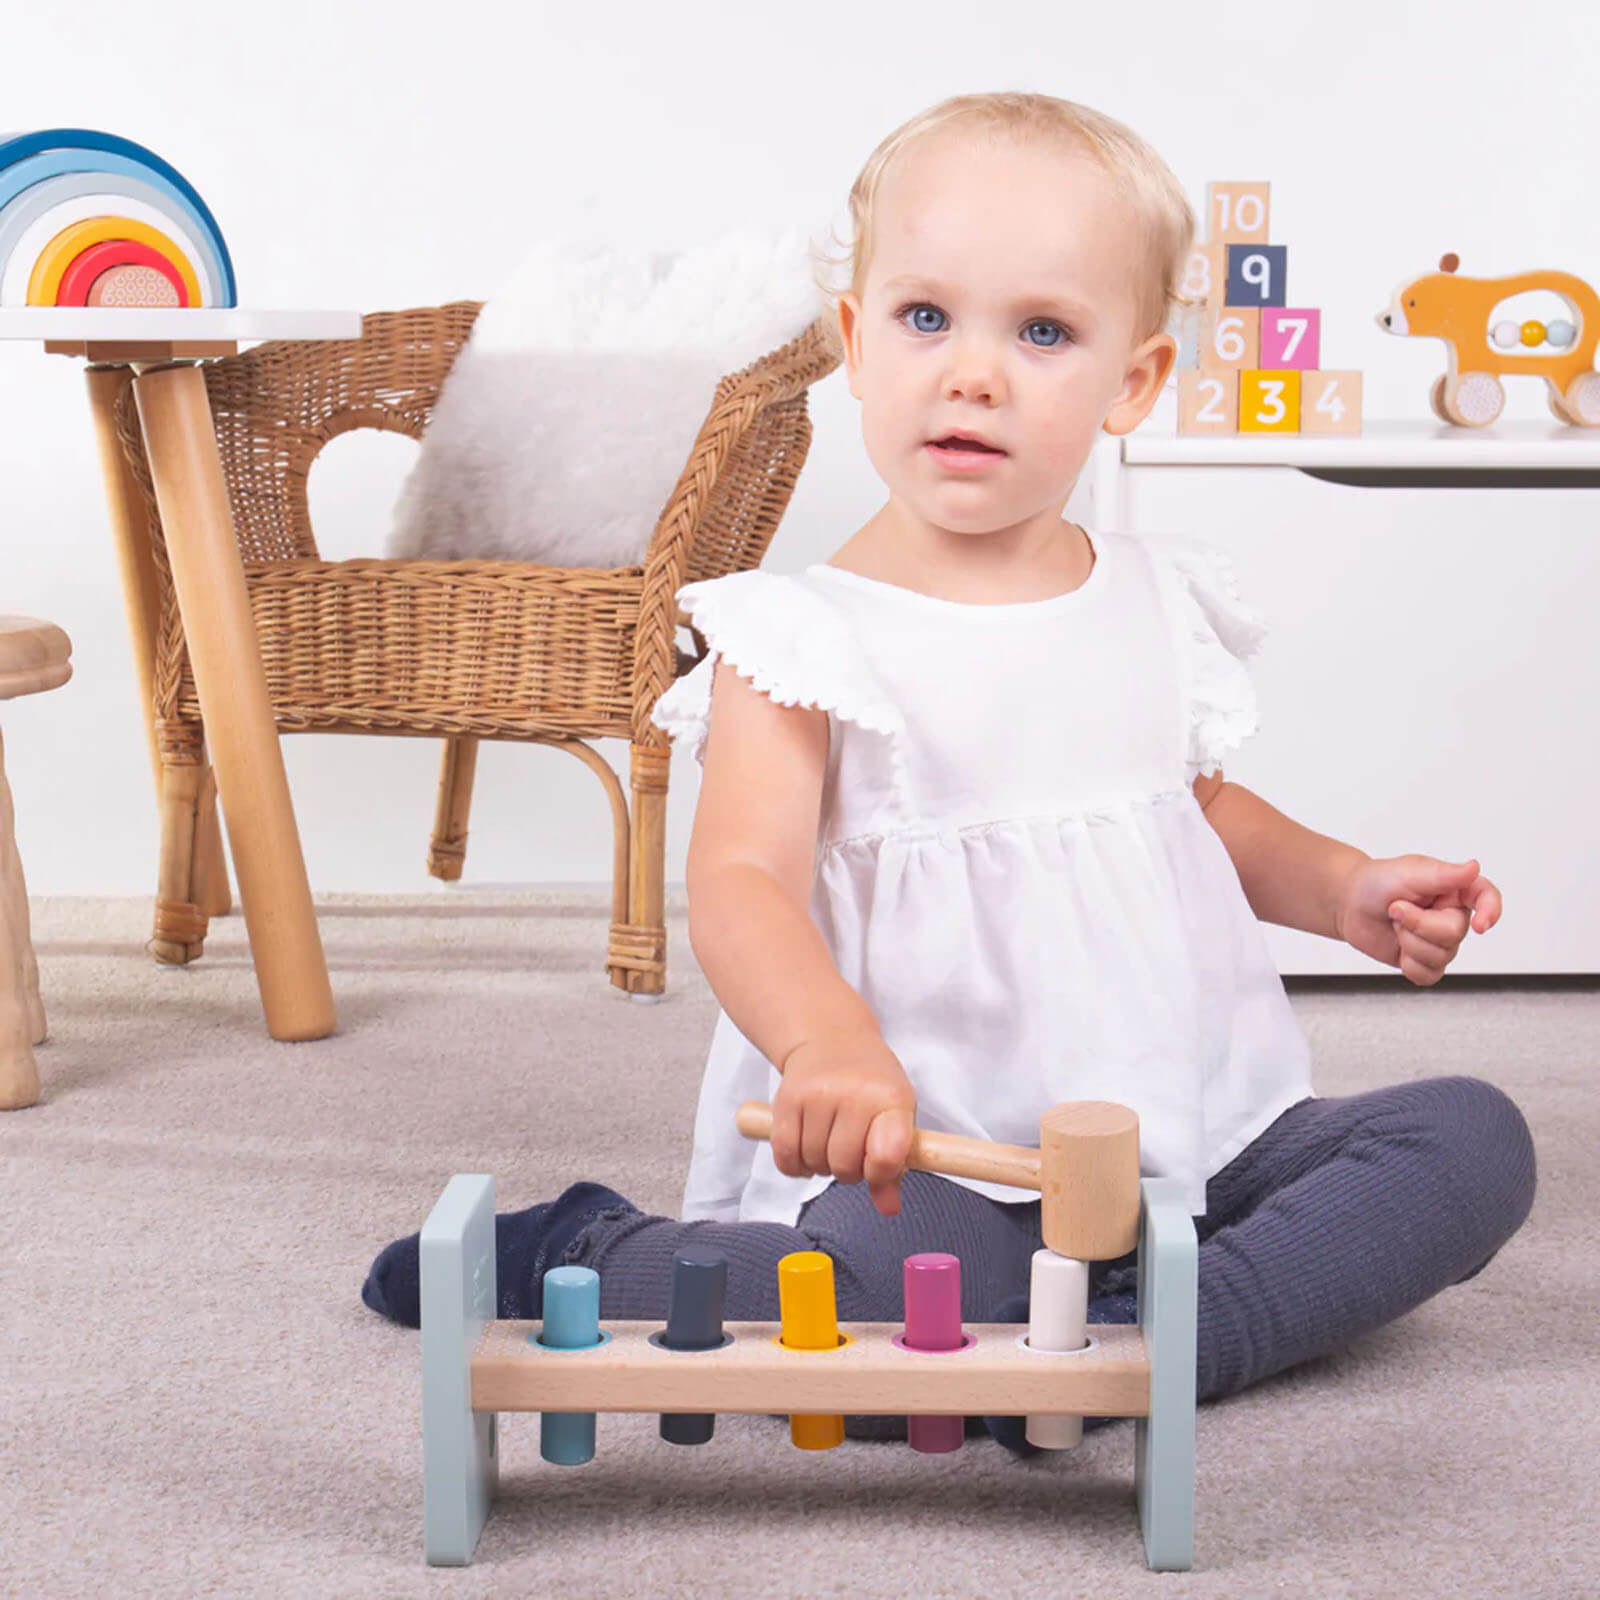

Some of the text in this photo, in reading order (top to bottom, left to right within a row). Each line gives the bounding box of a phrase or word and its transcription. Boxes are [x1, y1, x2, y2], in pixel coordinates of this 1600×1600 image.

[1215, 194, 1265, 232] 10
[1181, 253, 1211, 297] 8
[1241, 254, 1271, 299] 9
[1214, 317, 1245, 361] 6
[1277, 319, 1308, 362] 7
[1196, 379, 1225, 422] 2
[1256, 380, 1286, 424] 3
[1315, 380, 1345, 422] 4
